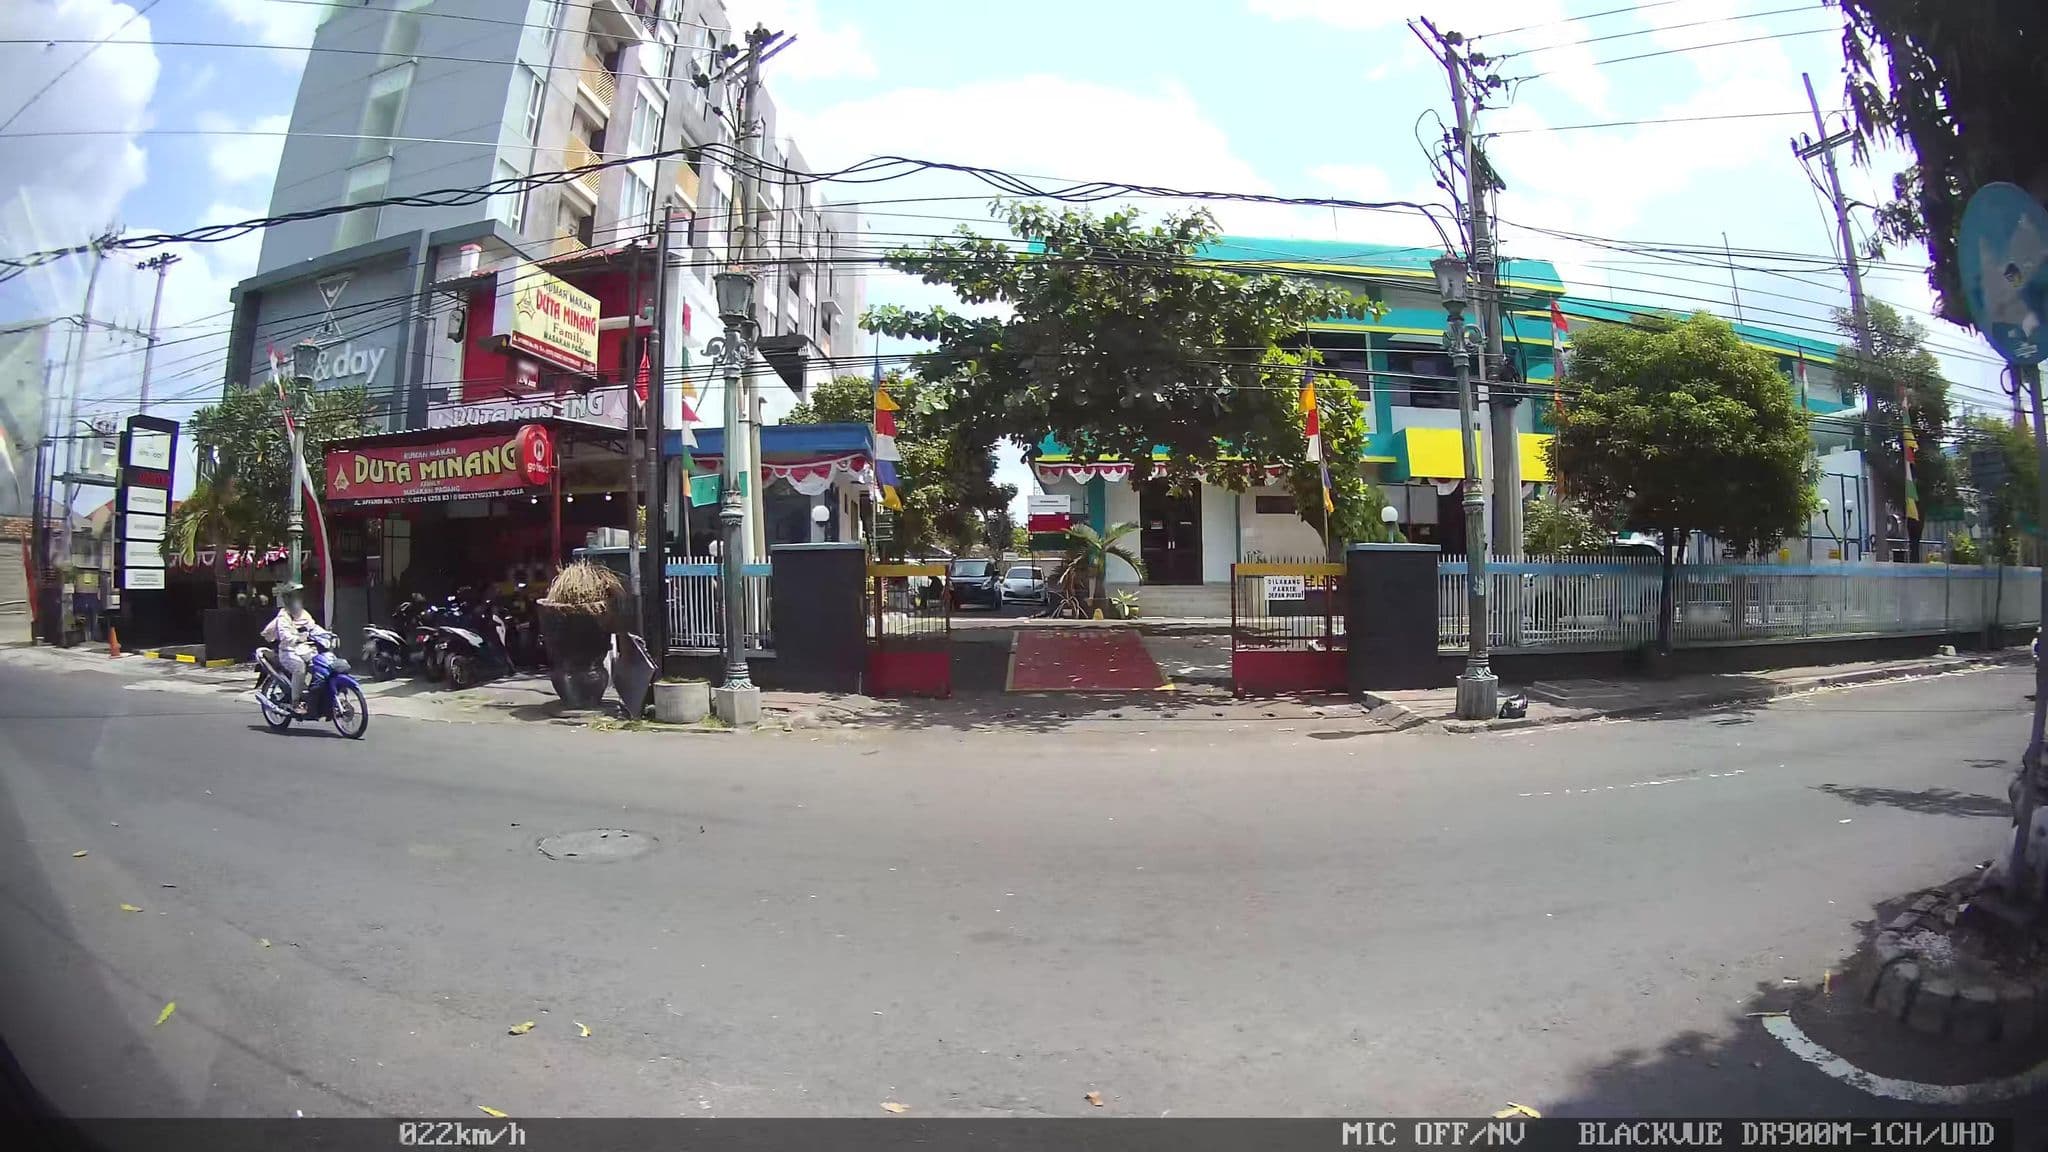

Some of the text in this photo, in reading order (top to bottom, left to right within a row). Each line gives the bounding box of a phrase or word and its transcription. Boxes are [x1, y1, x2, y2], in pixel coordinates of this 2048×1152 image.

[536, 288, 597, 337] DUTA MINANG
[569, 292, 593, 312] MAKAN
[553, 322, 585, 346] Family
[333, 341, 387, 385] day
[453, 406, 506, 426] DUTA
[354, 439, 517, 485] DUTA MINANG
